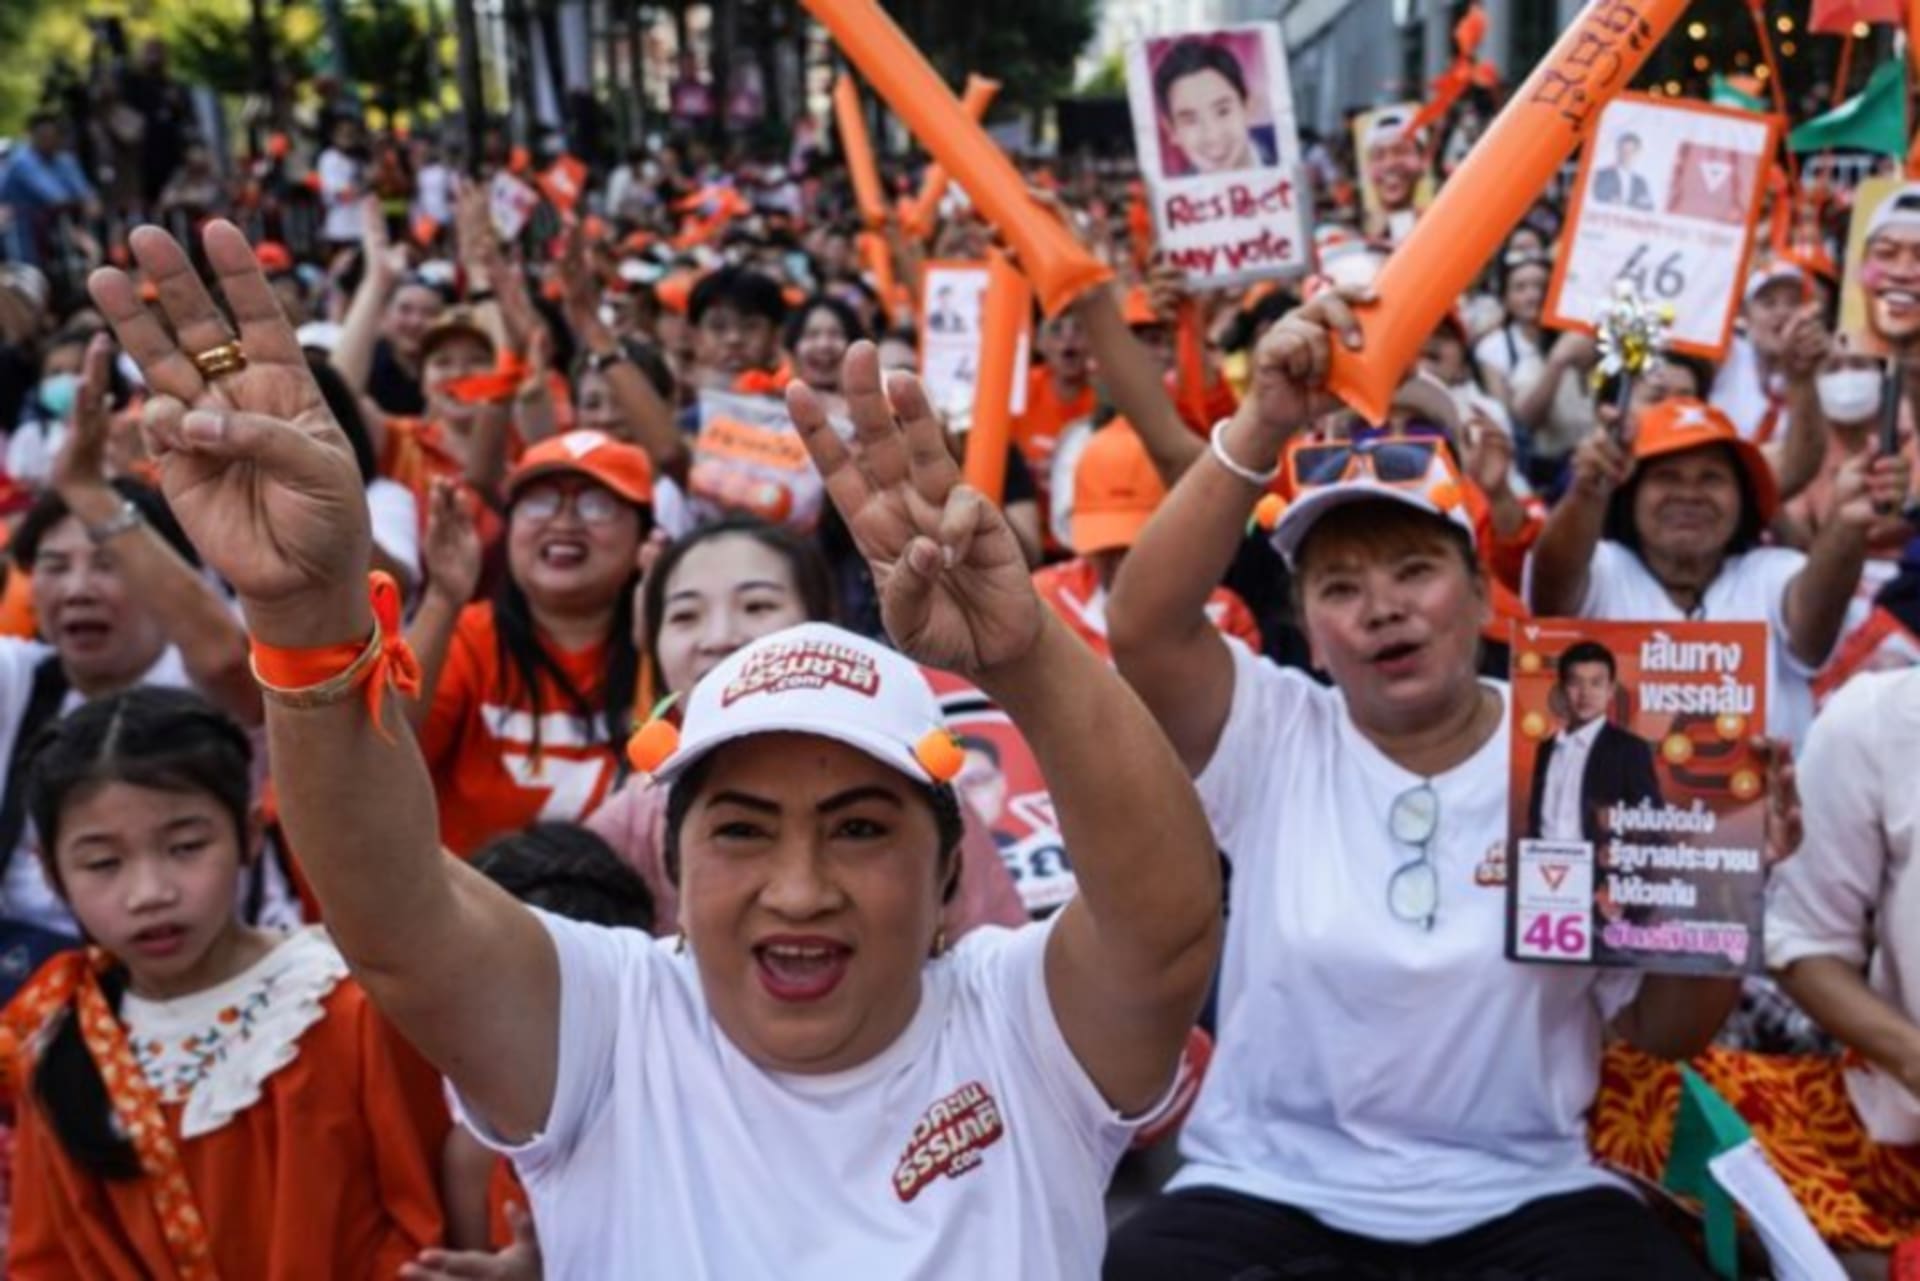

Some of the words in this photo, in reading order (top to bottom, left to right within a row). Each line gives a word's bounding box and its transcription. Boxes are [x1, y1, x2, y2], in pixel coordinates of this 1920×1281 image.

[1616, 243, 1685, 302] 46
[1640, 630, 1742, 672] เส้นทาง
[1639, 674, 1755, 714] พรรคส้ม
[1523, 912, 1586, 955] 46
